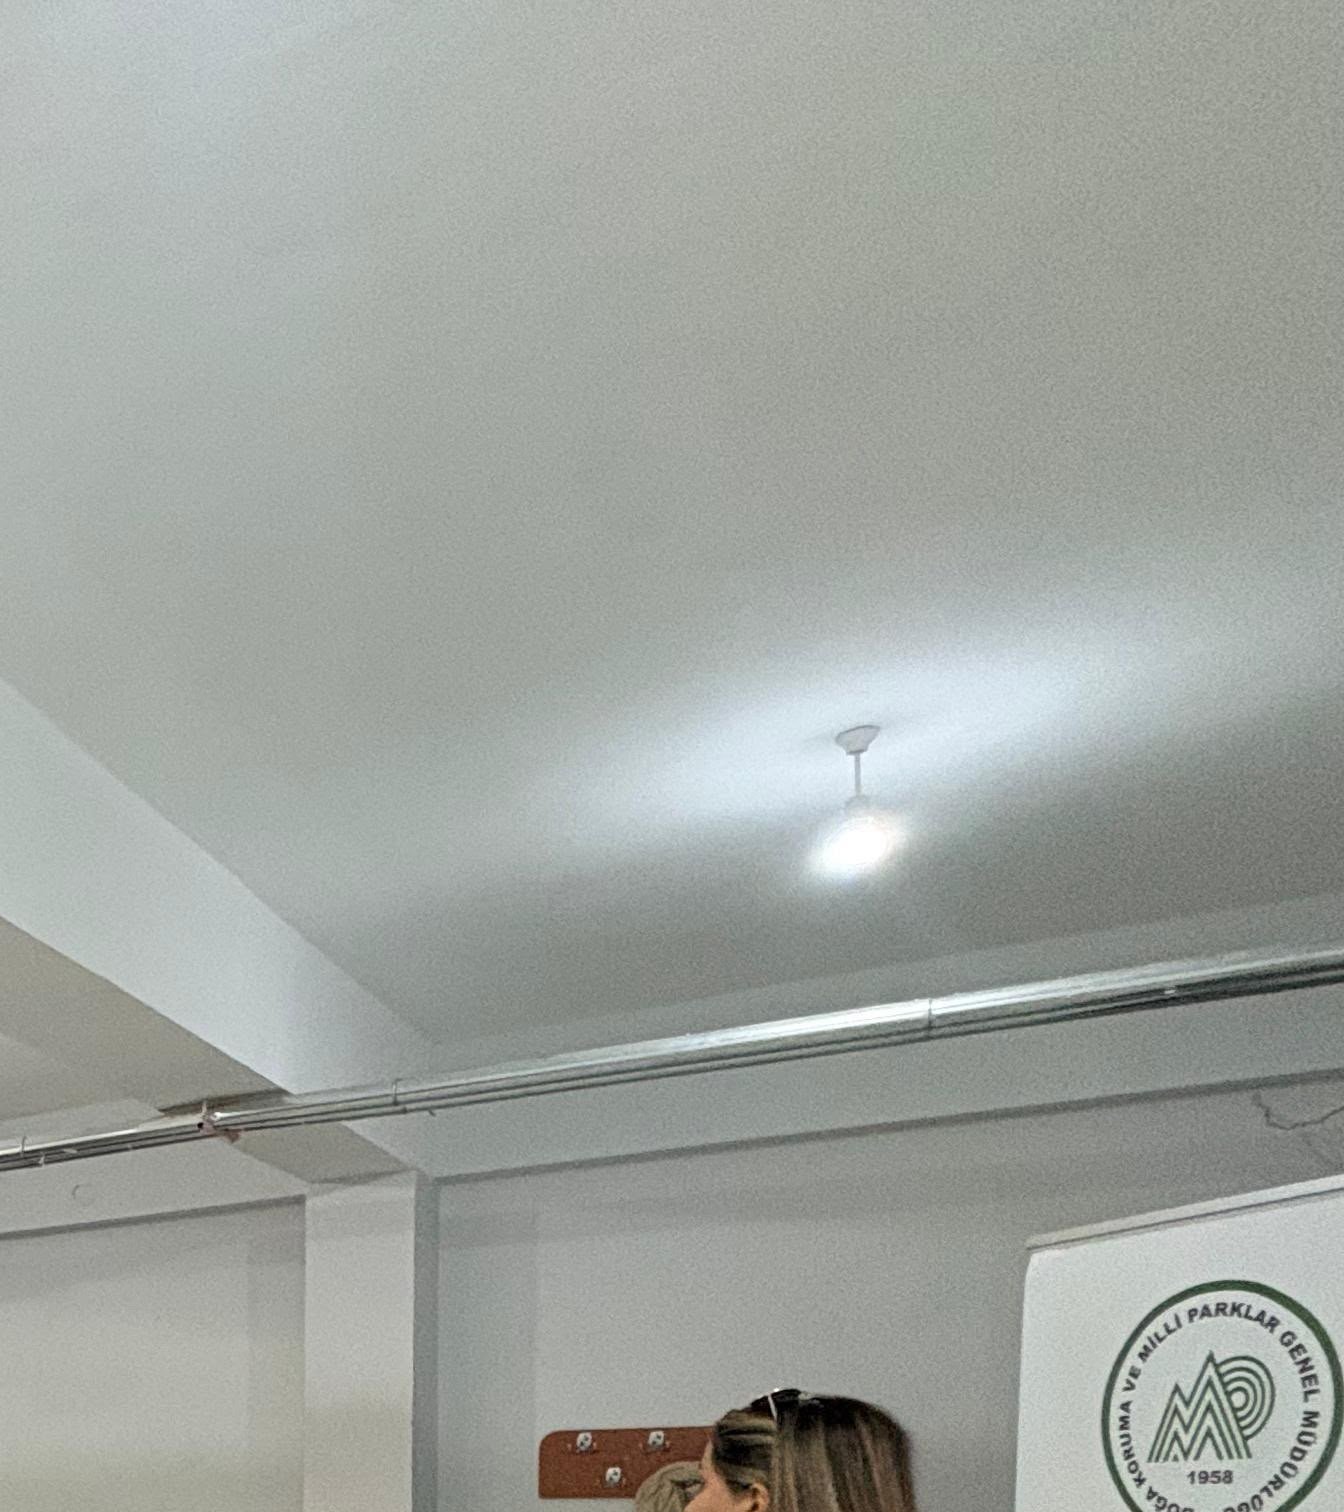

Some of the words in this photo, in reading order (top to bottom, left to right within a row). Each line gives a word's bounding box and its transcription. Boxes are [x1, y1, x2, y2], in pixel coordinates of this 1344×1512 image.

[1137, 1313, 1183, 1363] MİLLİ
[1187, 1301, 1281, 1334] PARKLAR
[1122, 1365, 1142, 1393] VE
[1279, 1330, 1321, 1403] GENEL
[1119, 1400, 1147, 1488] KORUMA
[1187, 1470, 1234, 1484] 1958
